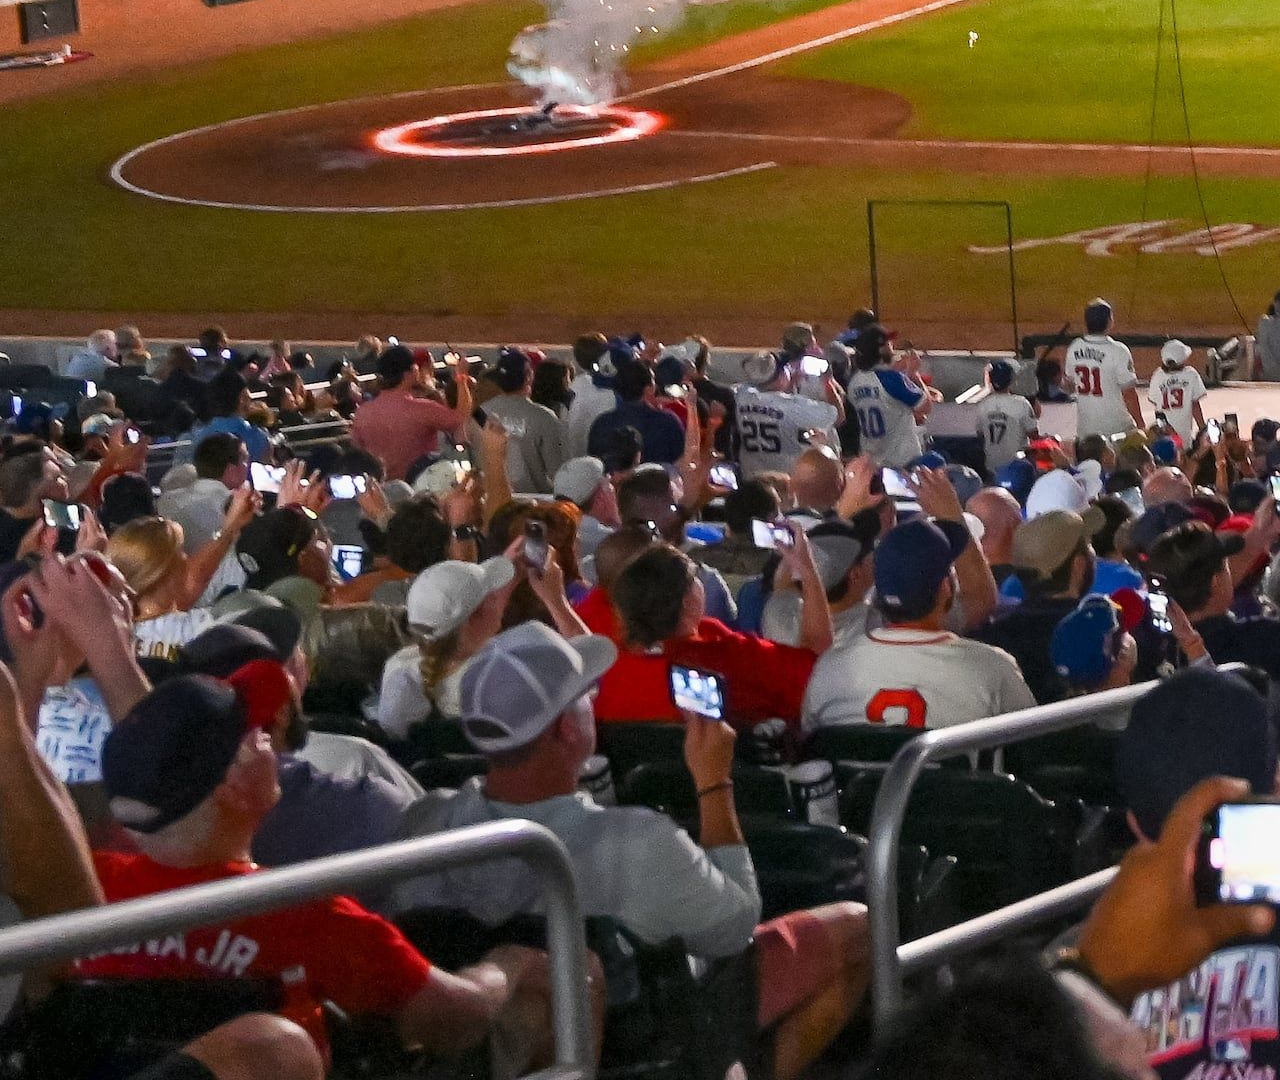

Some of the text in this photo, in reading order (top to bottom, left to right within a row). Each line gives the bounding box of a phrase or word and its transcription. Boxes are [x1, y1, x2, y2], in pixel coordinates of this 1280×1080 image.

[1074, 365, 1104, 397] 31
[1161, 388, 1185, 410] 13
[741, 420, 781, 453] 25
[857, 406, 886, 439] 10
